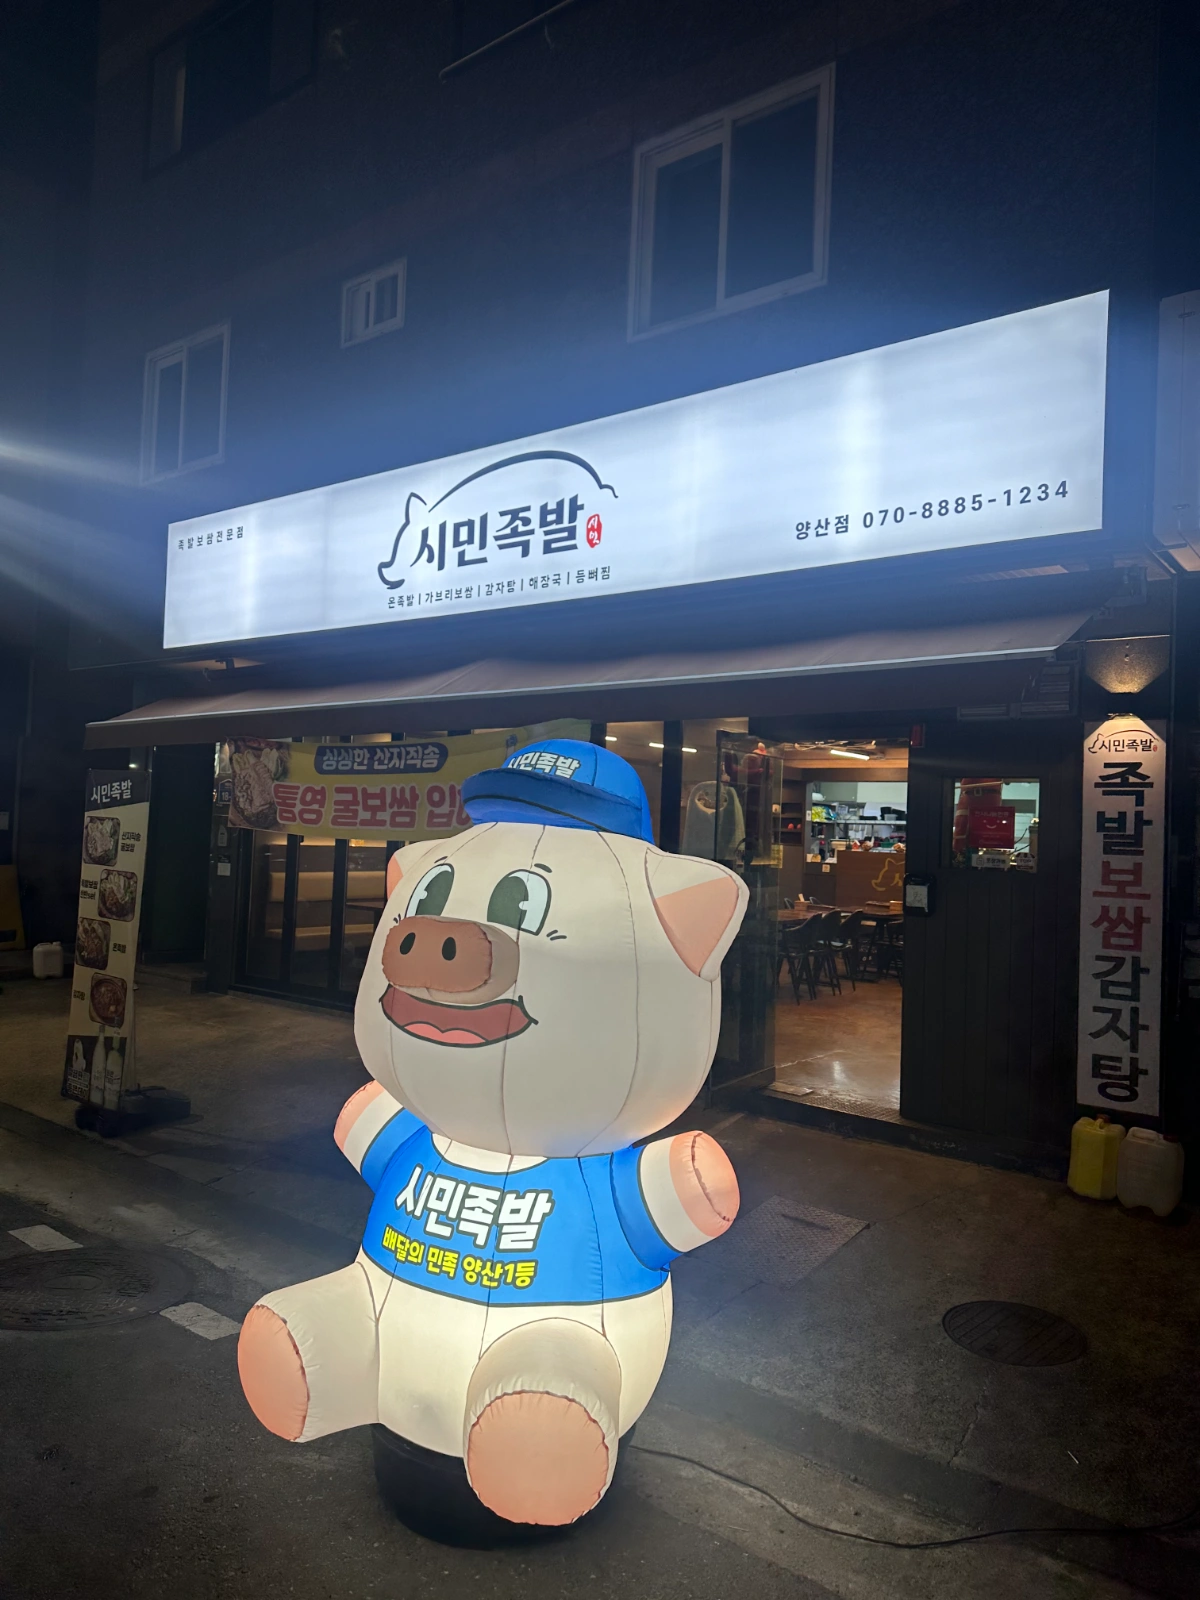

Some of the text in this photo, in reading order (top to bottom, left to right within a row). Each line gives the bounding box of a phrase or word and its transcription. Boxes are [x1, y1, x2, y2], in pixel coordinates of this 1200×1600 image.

[410, 493, 584, 571] 시민족발
[795, 480, 1068, 540] 양산점 070-8885-1234
[178, 525, 244, 550] 족발보쌈전문점
[387, 565, 611, 609] 온족발 가브리보쌈 감자탕 해장국 등뼈찜
[322, 745, 440, 771] 싱싱한 산지직송
[507, 752, 581, 778] 시민족발
[1098, 738, 1154, 753] 시민족발
[91, 779, 132, 804] 시민족발
[273, 783, 472, 828] 통영 굴보쌈 입
[1088, 761, 1154, 1103] 족발 보쌈 감자탕
[395, 1164, 554, 1251] 시민족발
[382, 1225, 536, 1287] 배달의 민족 양산1등
